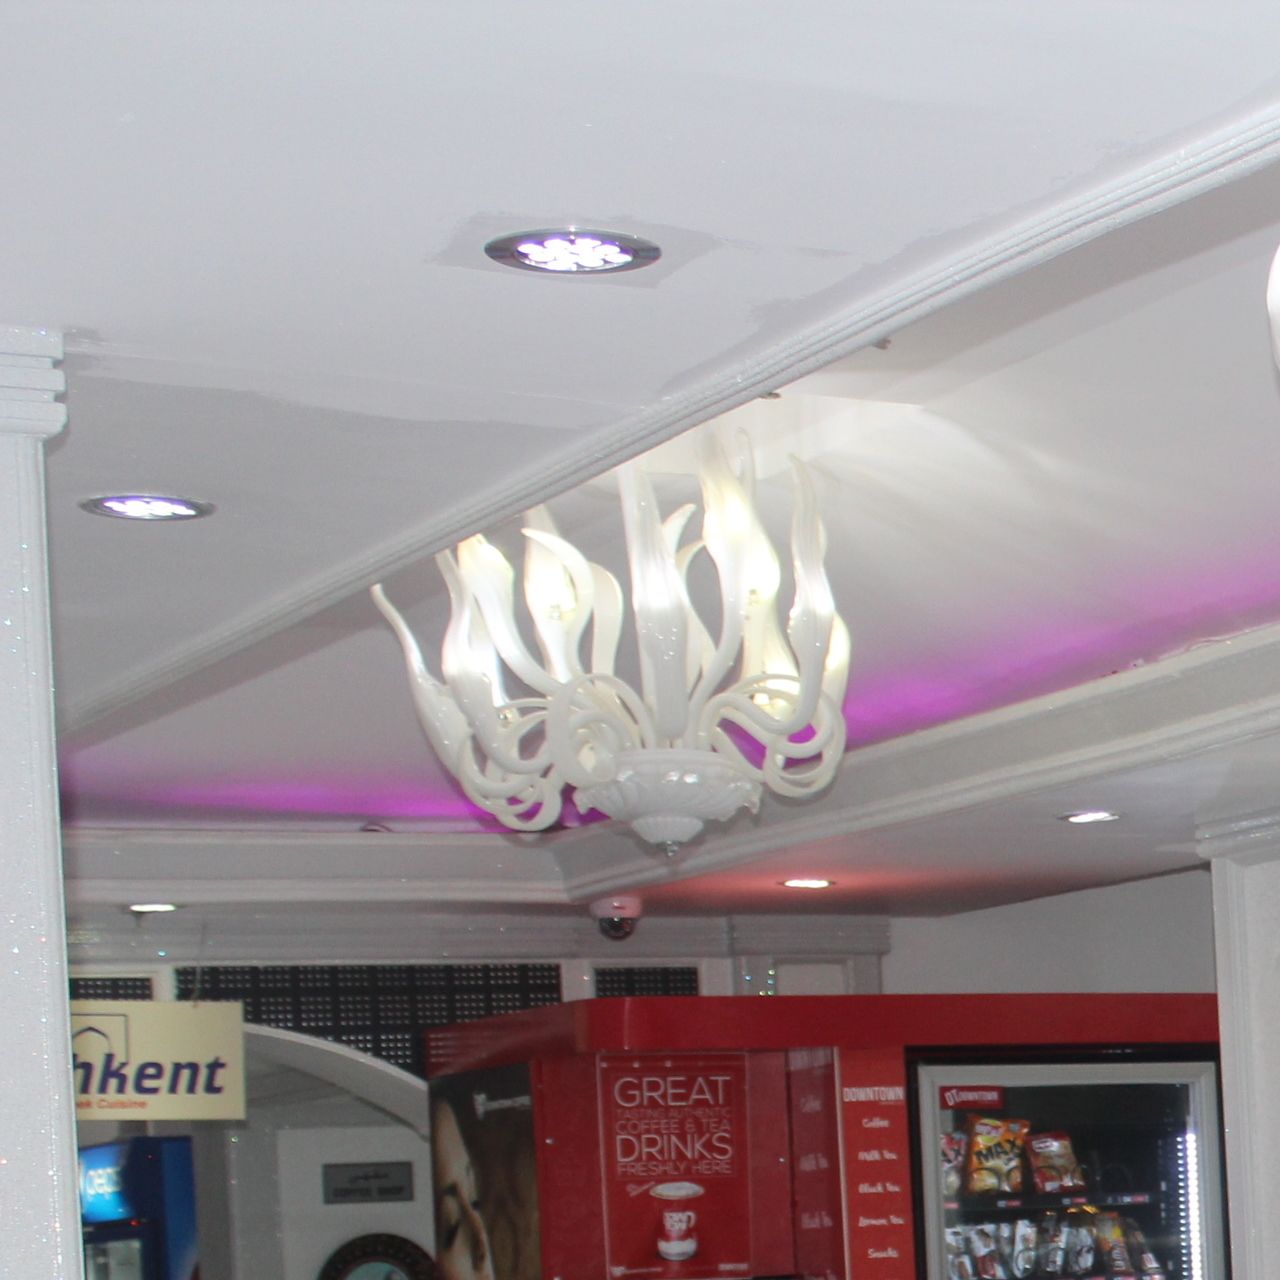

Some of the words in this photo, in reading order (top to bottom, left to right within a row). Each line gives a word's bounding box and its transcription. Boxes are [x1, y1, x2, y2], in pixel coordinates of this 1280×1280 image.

[614, 1076, 731, 1107] GREAT
[843, 1086, 904, 1102] DOWNTOWN
[616, 1120, 680, 1134] COFFEE
[702, 1119, 731, 1132] TEA
[862, 1117, 890, 1128] Coffee
[616, 1133, 732, 1161] DRINKS
[618, 1162, 687, 1176] FRESHLY
[693, 1161, 732, 1175] HERE
[858, 1182, 884, 1194] Black
[867, 1248, 899, 1259] Snacks
